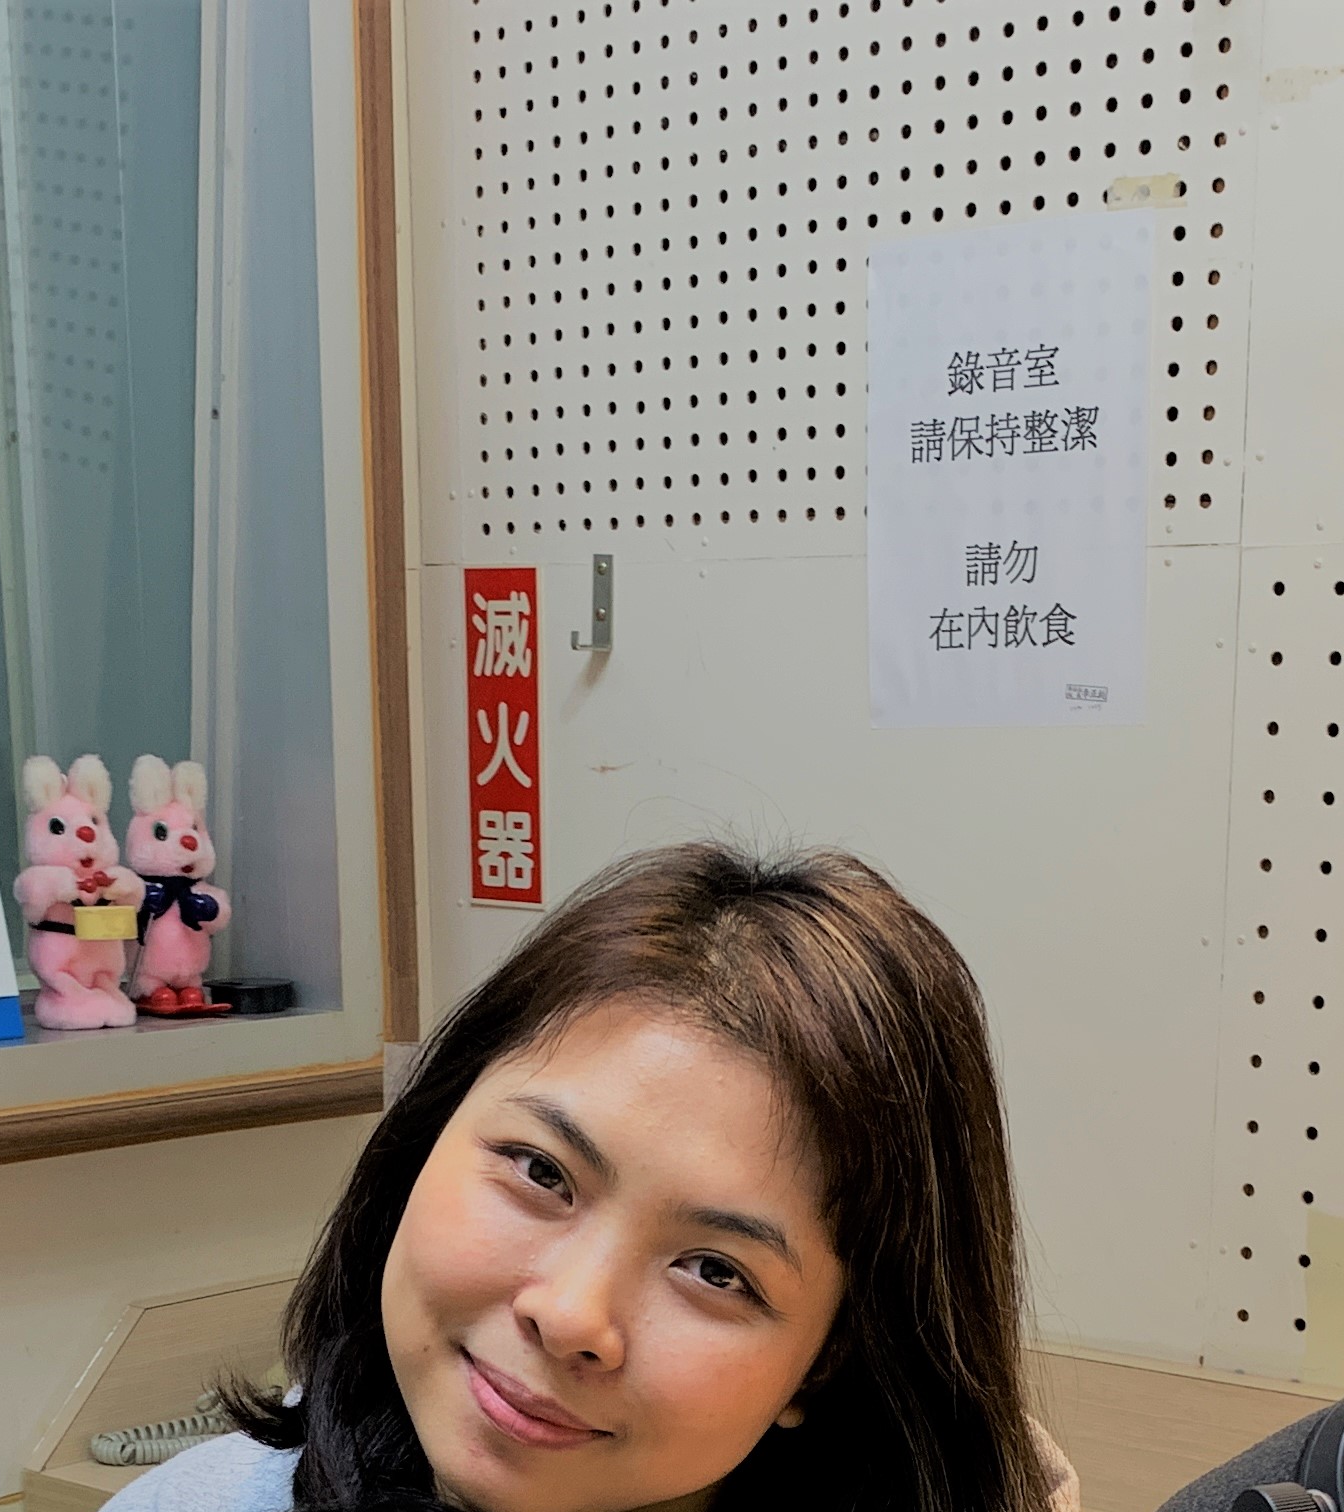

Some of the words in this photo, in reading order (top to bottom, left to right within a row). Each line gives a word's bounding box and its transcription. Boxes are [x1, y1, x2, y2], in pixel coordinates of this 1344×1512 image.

[946, 343, 1060, 397] 錄音室
[910, 405, 1100, 464] 請保持整潔
[965, 539, 1039, 587] 請勿
[928, 602, 1078, 651] 在內飲食
[471, 590, 534, 890] 滅火器
